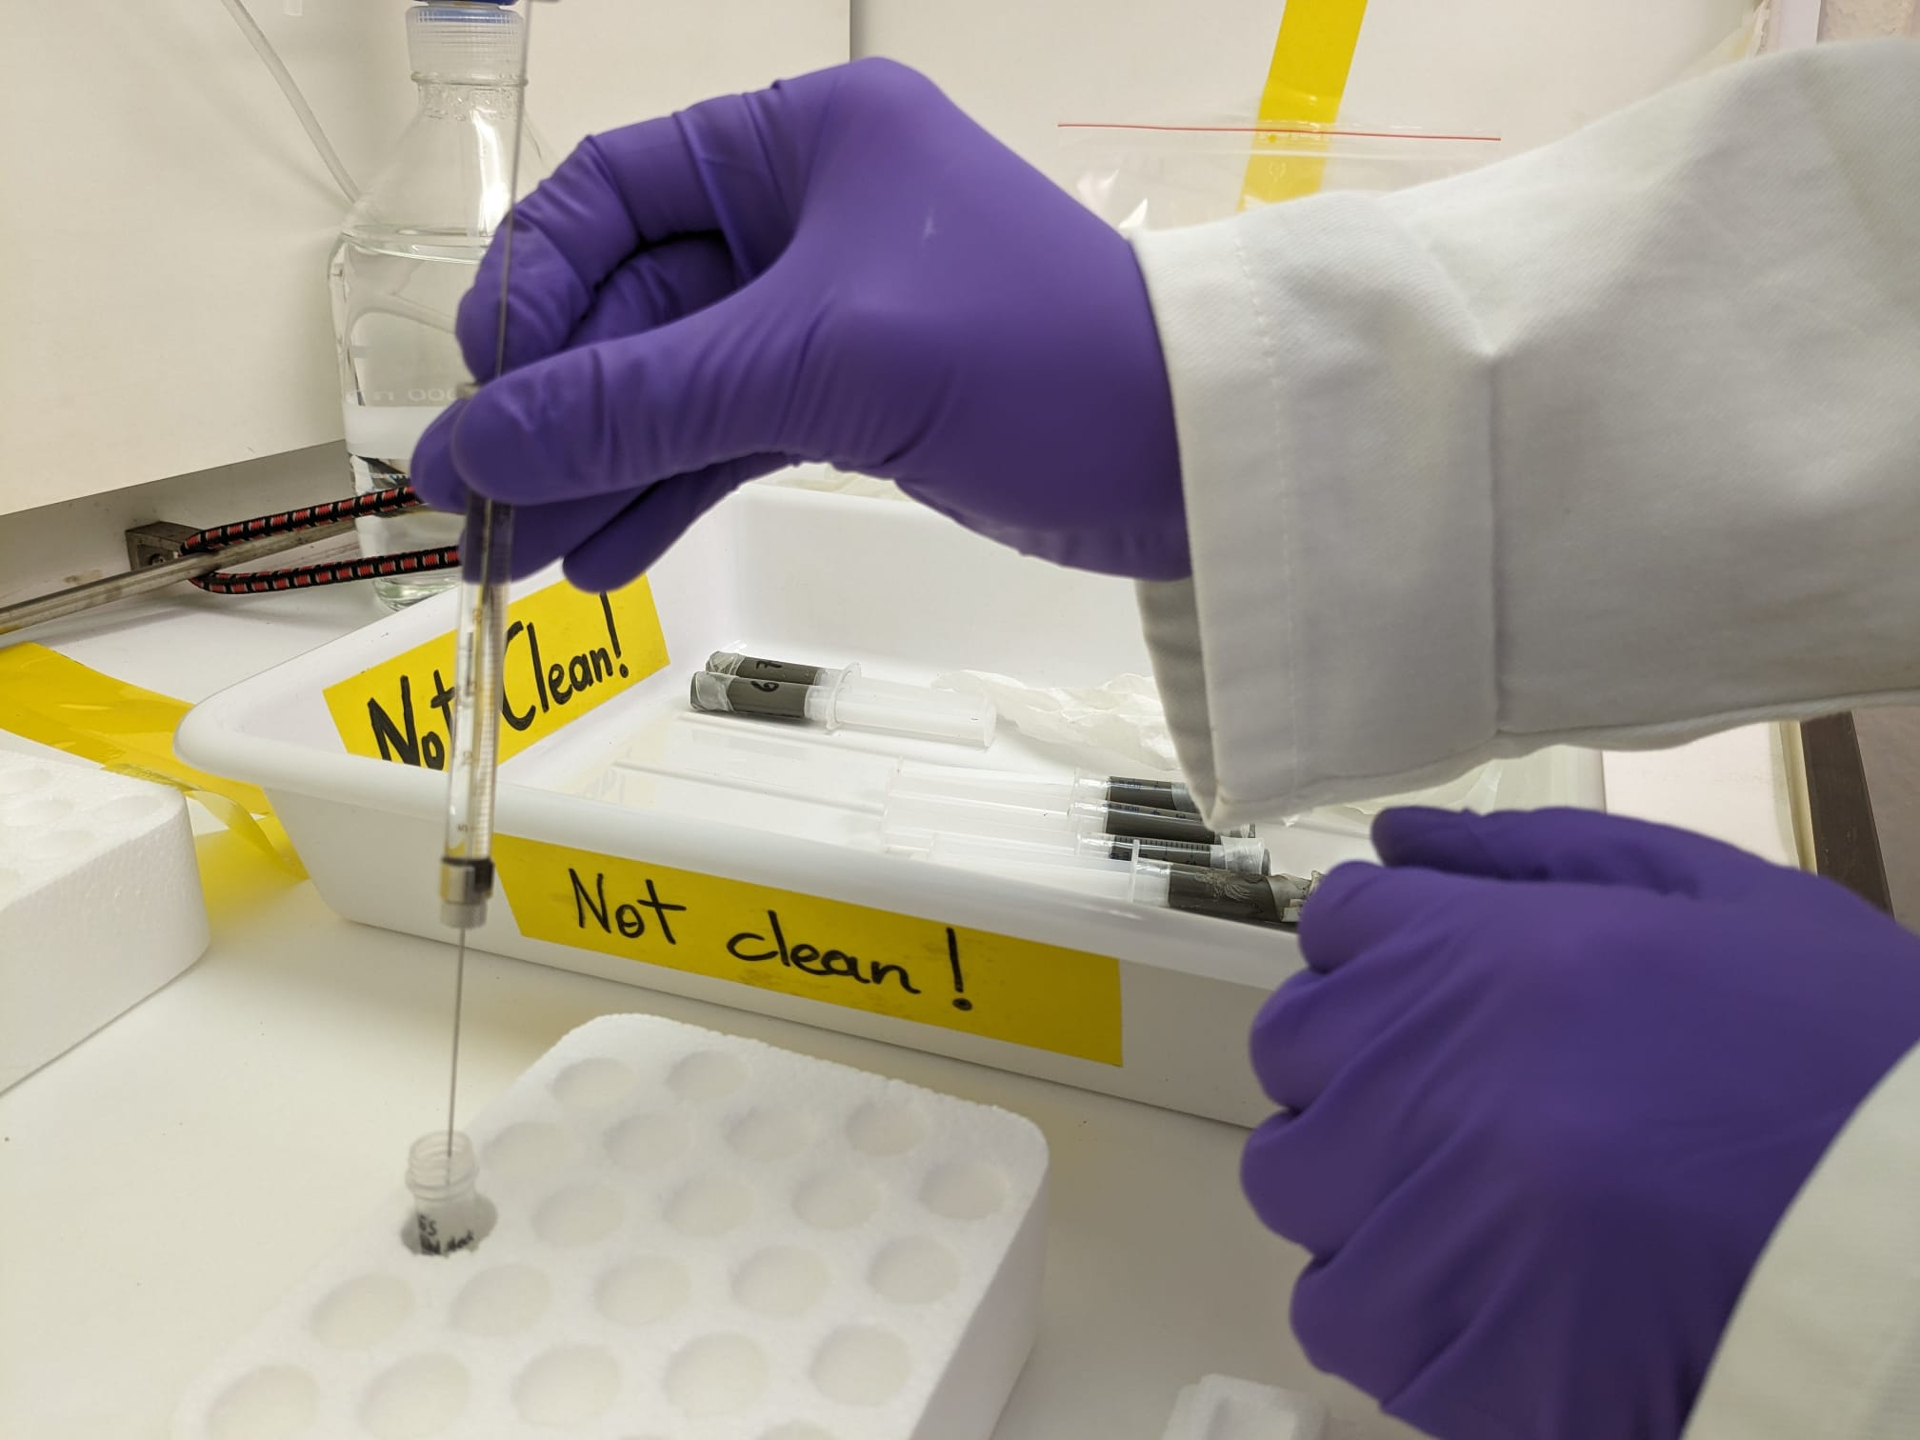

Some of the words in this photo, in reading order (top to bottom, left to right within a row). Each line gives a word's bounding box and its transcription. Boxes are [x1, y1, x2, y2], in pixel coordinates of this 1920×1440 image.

[367, 668, 455, 771] Not
[501, 590, 630, 732] Clean!
[568, 867, 687, 945] Not
